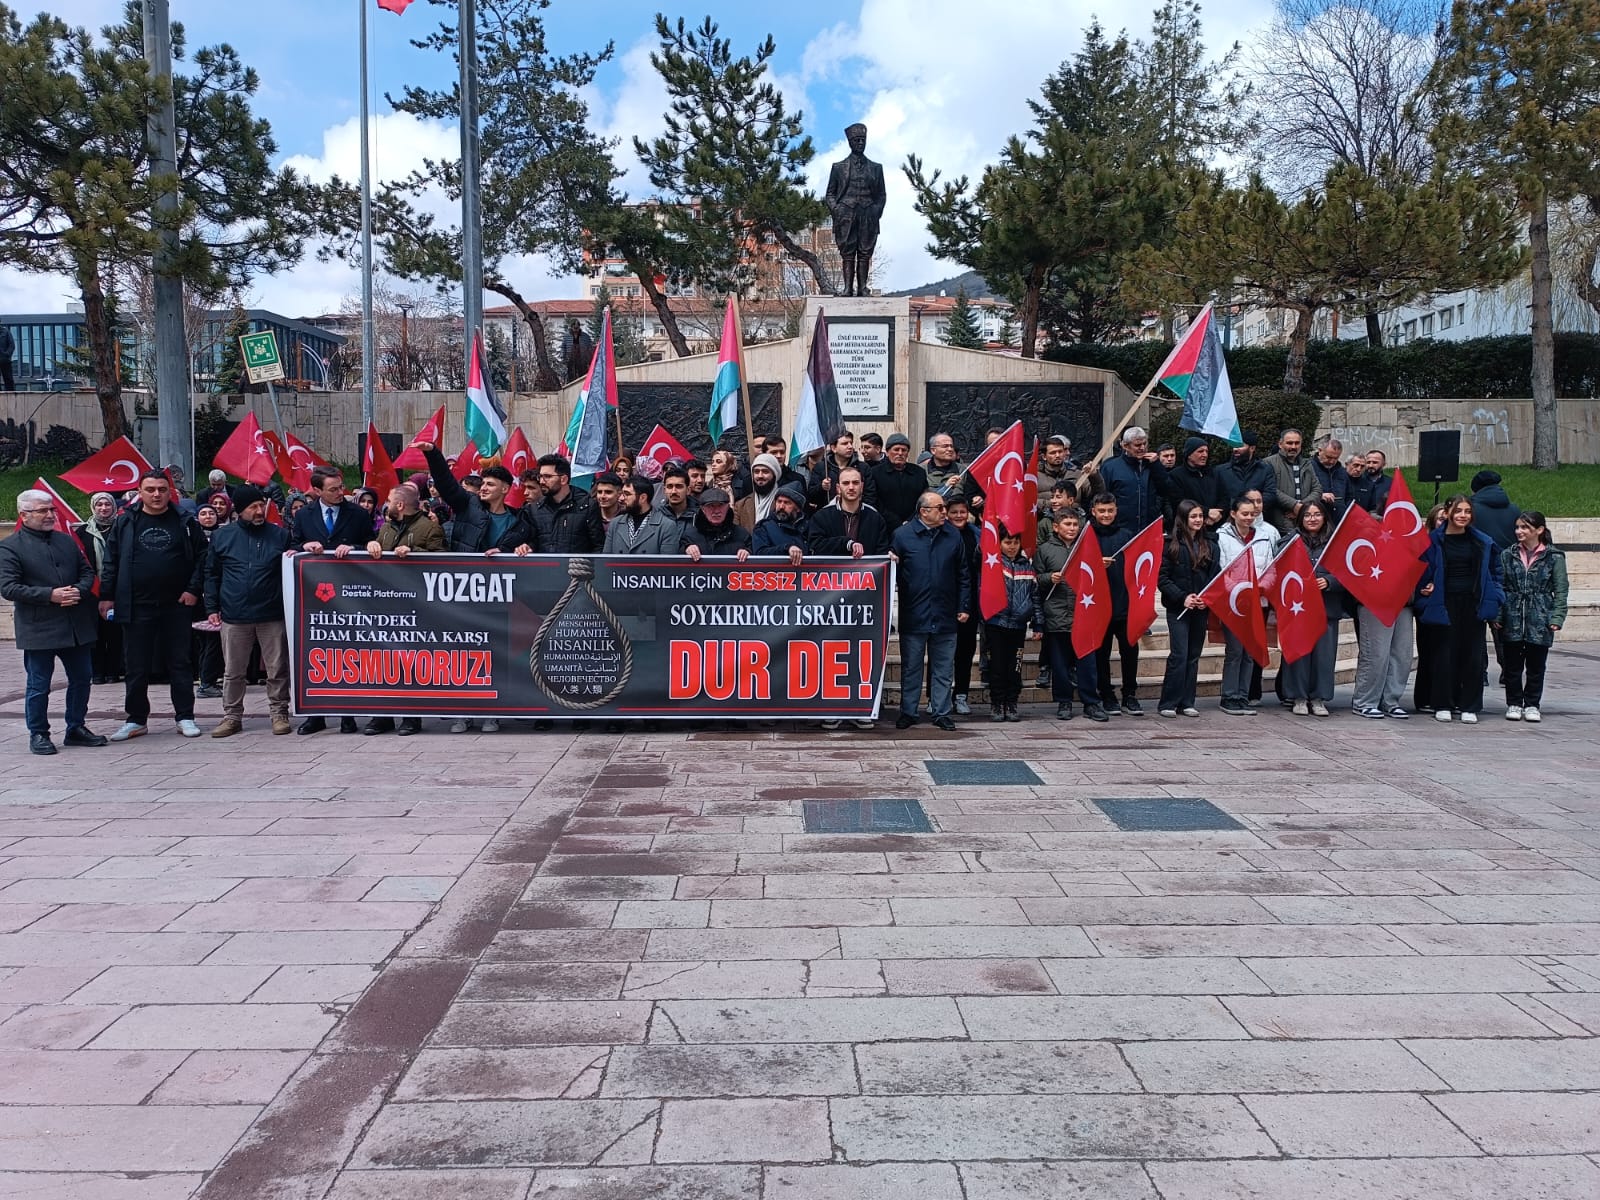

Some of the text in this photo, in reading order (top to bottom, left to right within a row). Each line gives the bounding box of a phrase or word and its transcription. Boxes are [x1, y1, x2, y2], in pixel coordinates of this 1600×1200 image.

[423, 572, 517, 603] YOZGAT
[612, 572, 686, 589] İNSANLIK
[690, 572, 722, 592] İÇİN
[801, 571, 876, 591] KALMA
[342, 589, 417, 598] Destek Platformu
[309, 610, 417, 627] FİLİSTİN'DEKİ
[670, 598, 874, 626] SOYKIRIMCI İSRAİL'E
[309, 629, 489, 646] İDAM KARARINA KARŞI
[555, 626, 610, 638] HUMANITÉ
[548, 637, 616, 651] İNSANLIK
[543, 653, 590, 661] HUMANIDAD
[308, 648, 493, 686] SUSMUYORUZ!
[544, 662, 583, 672] UMANITÀ
[669, 640, 771, 700] DUR
[547, 675, 617, 683] ЧЕЛОВЕЧЕСТВО
